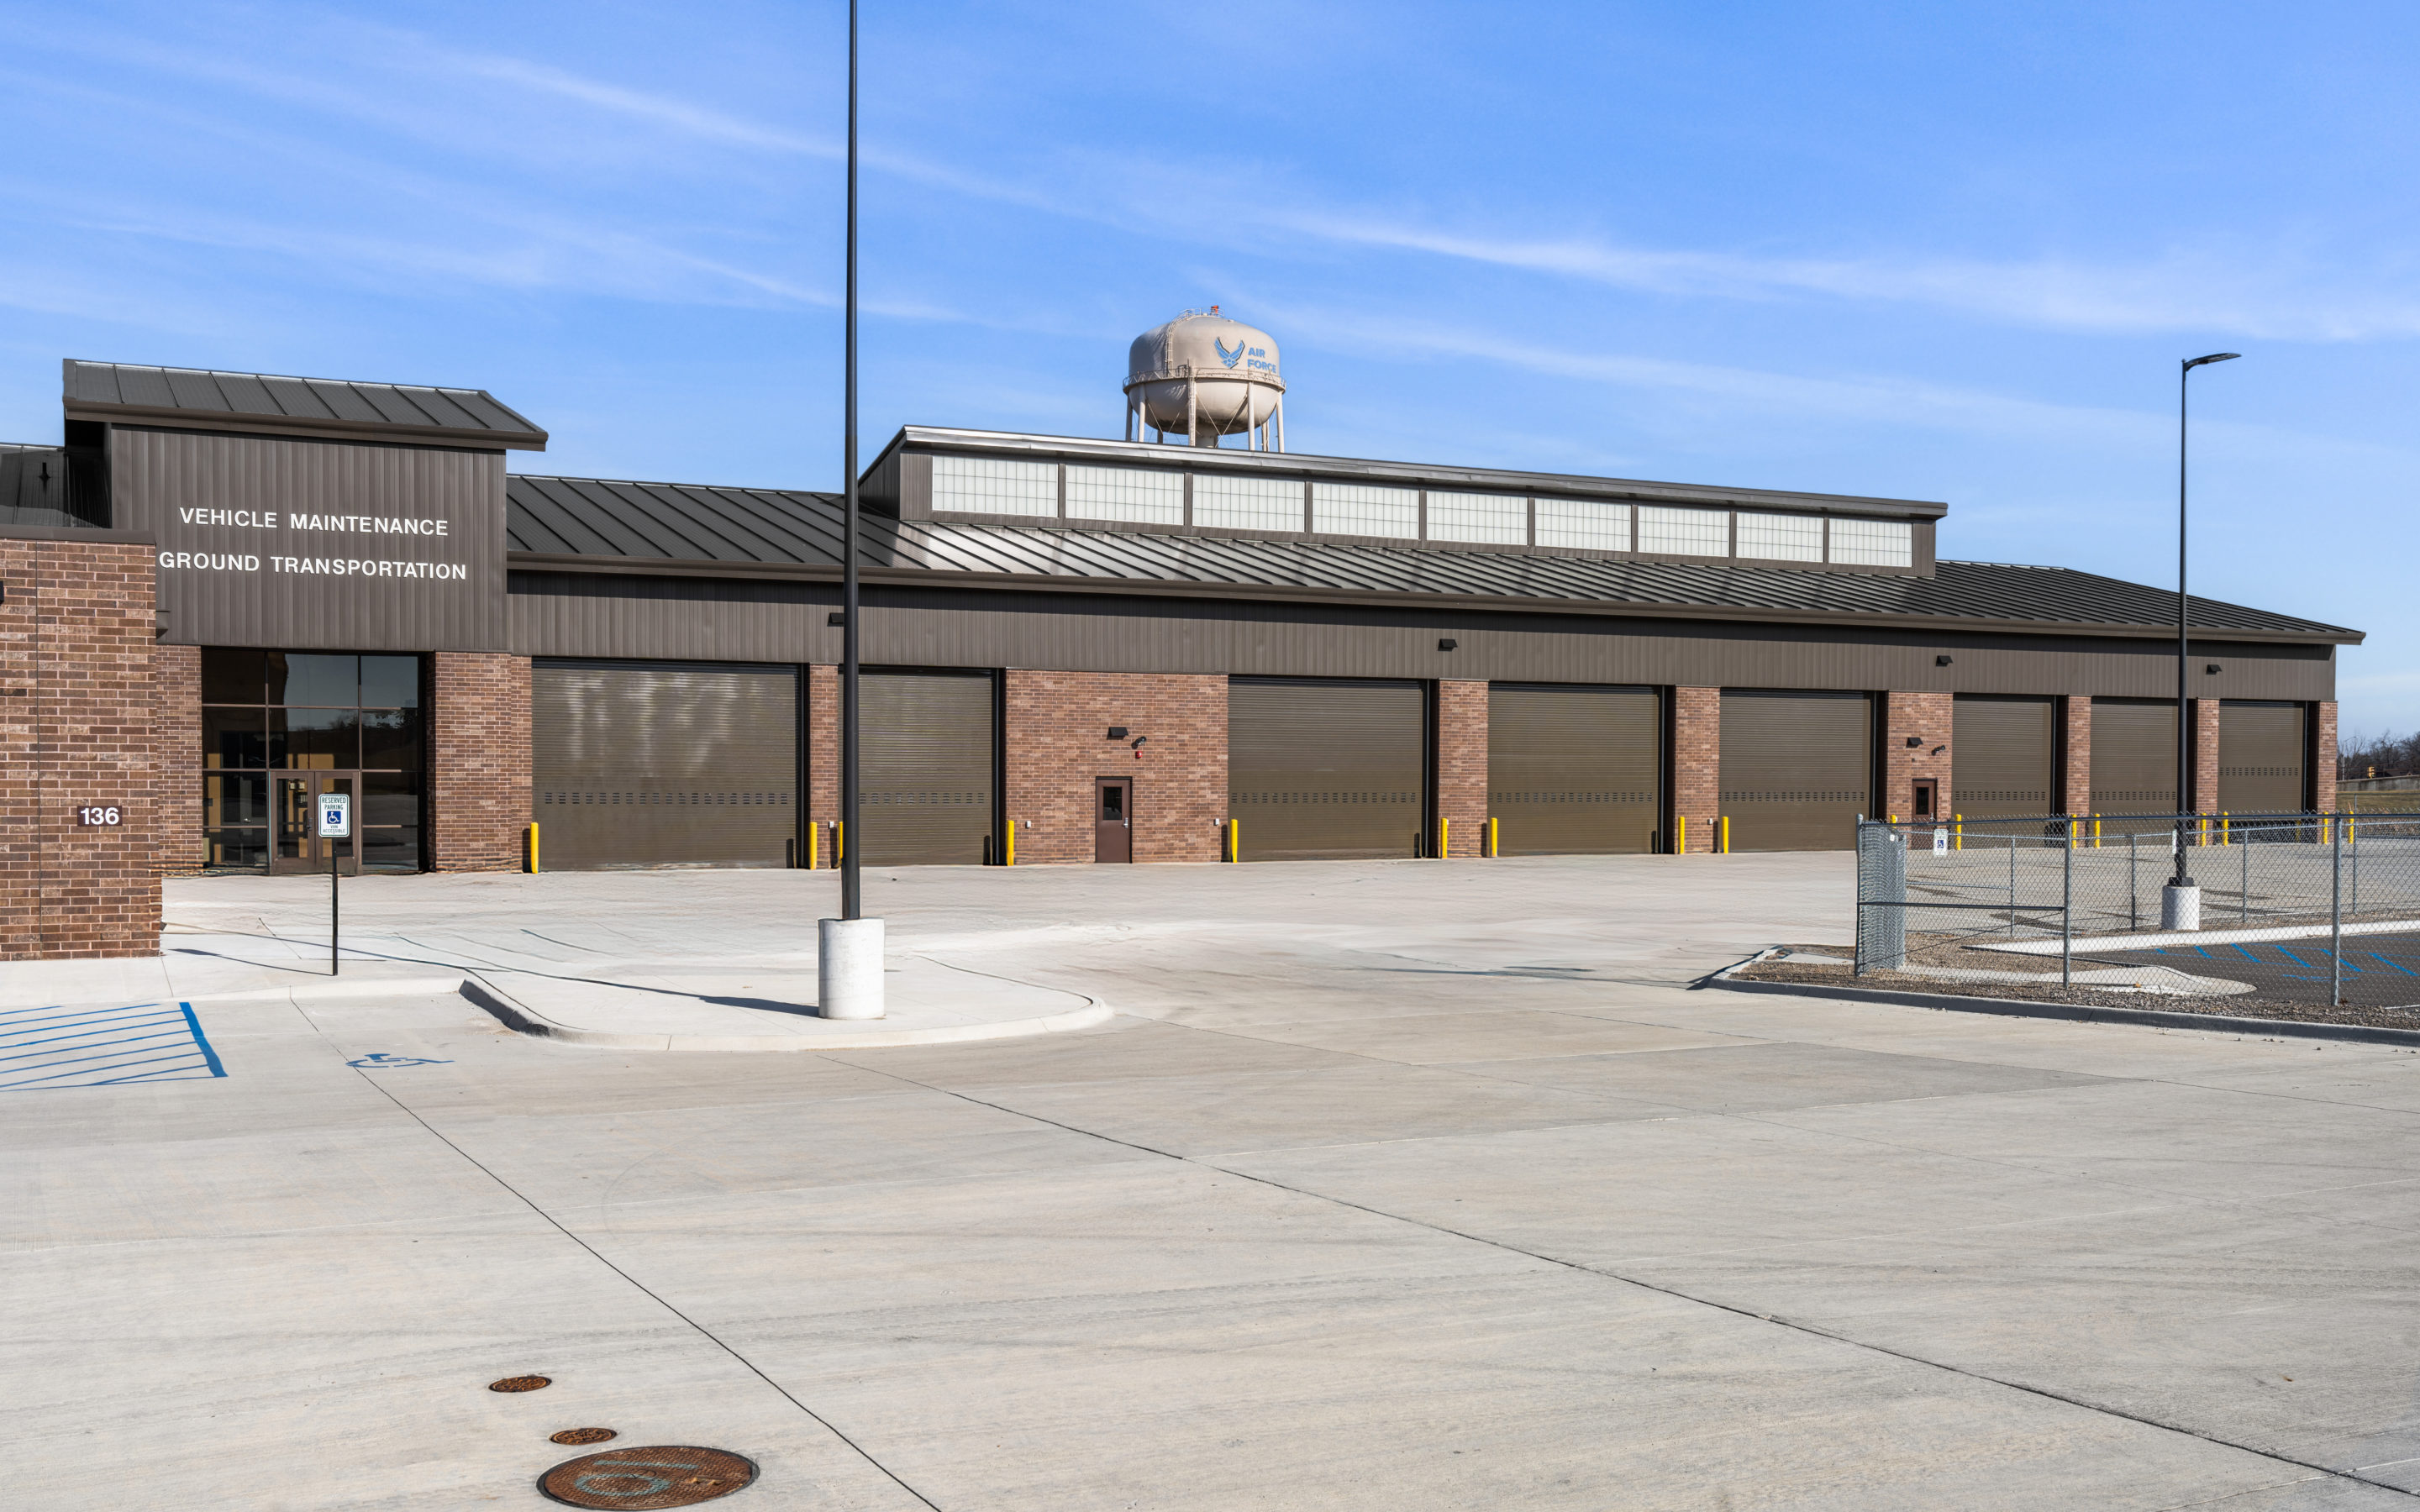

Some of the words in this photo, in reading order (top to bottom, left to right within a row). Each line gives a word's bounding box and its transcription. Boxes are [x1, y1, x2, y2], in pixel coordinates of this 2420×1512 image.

[1248, 347, 1265, 358] AIR
[1247, 359, 1276, 374] FORCE
[179, 507, 278, 528] VEHICLE
[290, 513, 449, 536] MAINTENANCE
[159, 551, 260, 572] GROUND
[270, 556, 466, 580] TRANSPORTATION
[80, 807, 119, 825] 136
